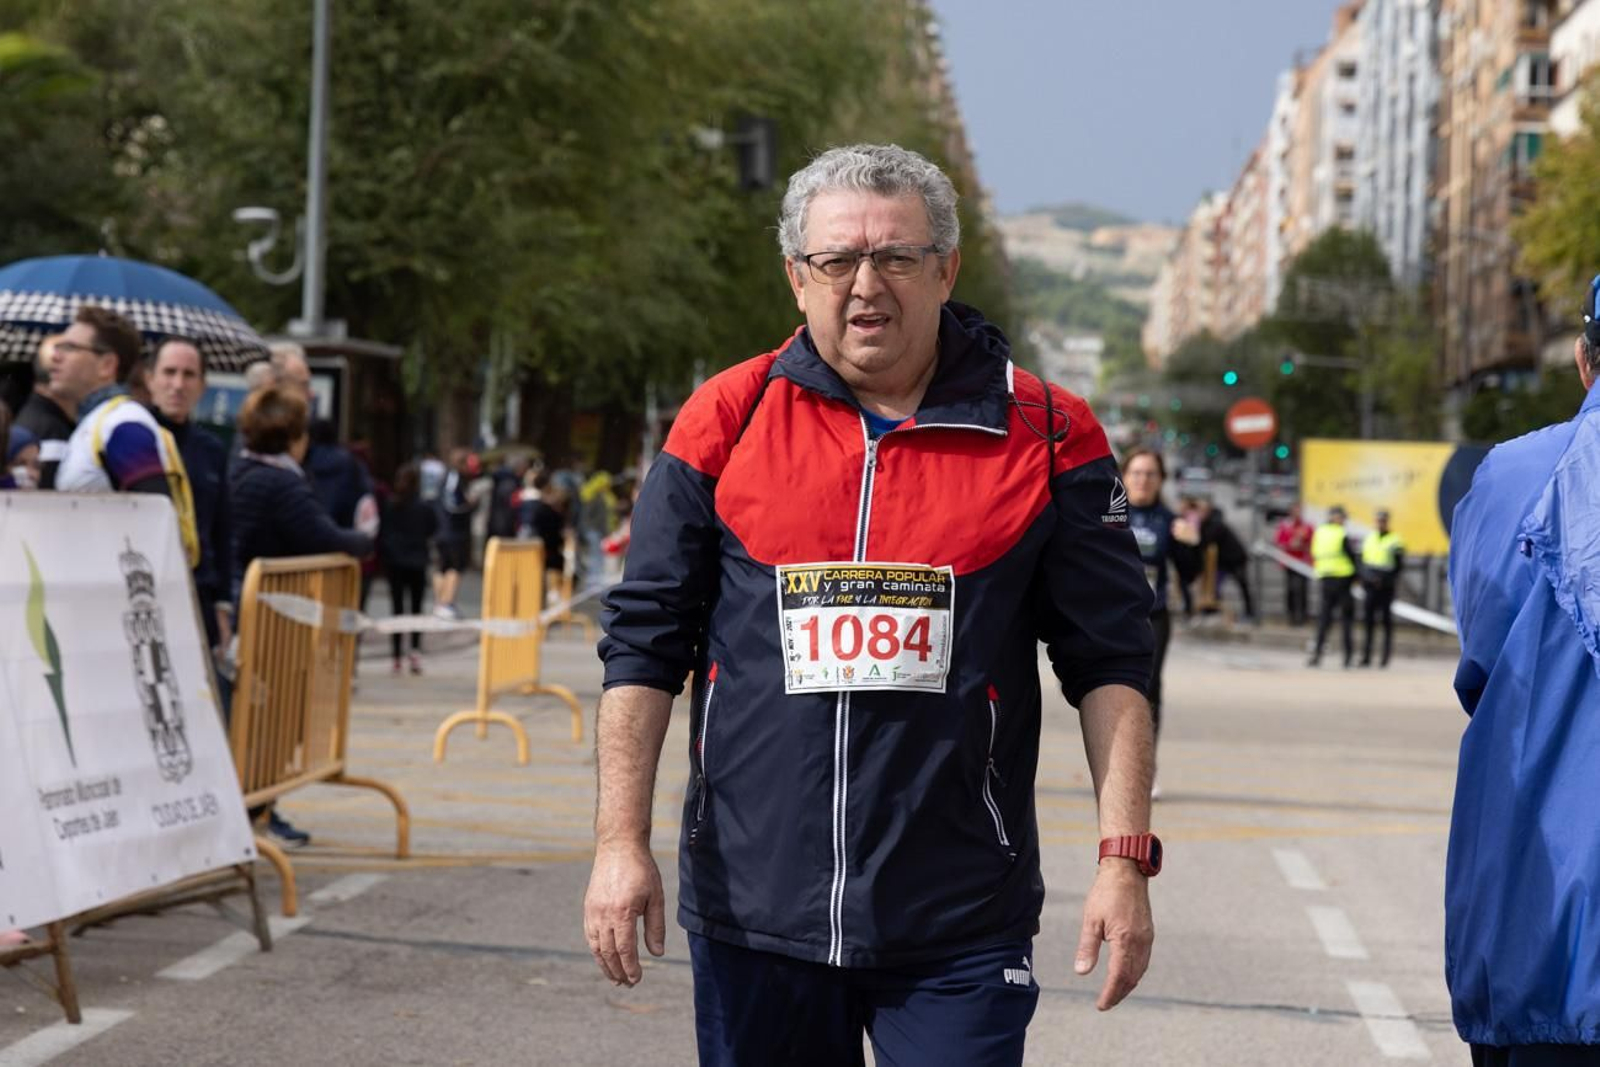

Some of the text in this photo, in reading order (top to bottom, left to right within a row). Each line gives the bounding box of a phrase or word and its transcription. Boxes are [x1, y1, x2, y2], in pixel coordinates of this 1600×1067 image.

[787, 571, 821, 594] XXV
[823, 570, 945, 583] CARRERA POPULAR
[823, 580, 945, 593] y gran caminata
[821, 596, 835, 604] LA
[863, 595, 877, 604] LA
[800, 614, 932, 662] 1084
[1003, 968, 1030, 987] PUM
